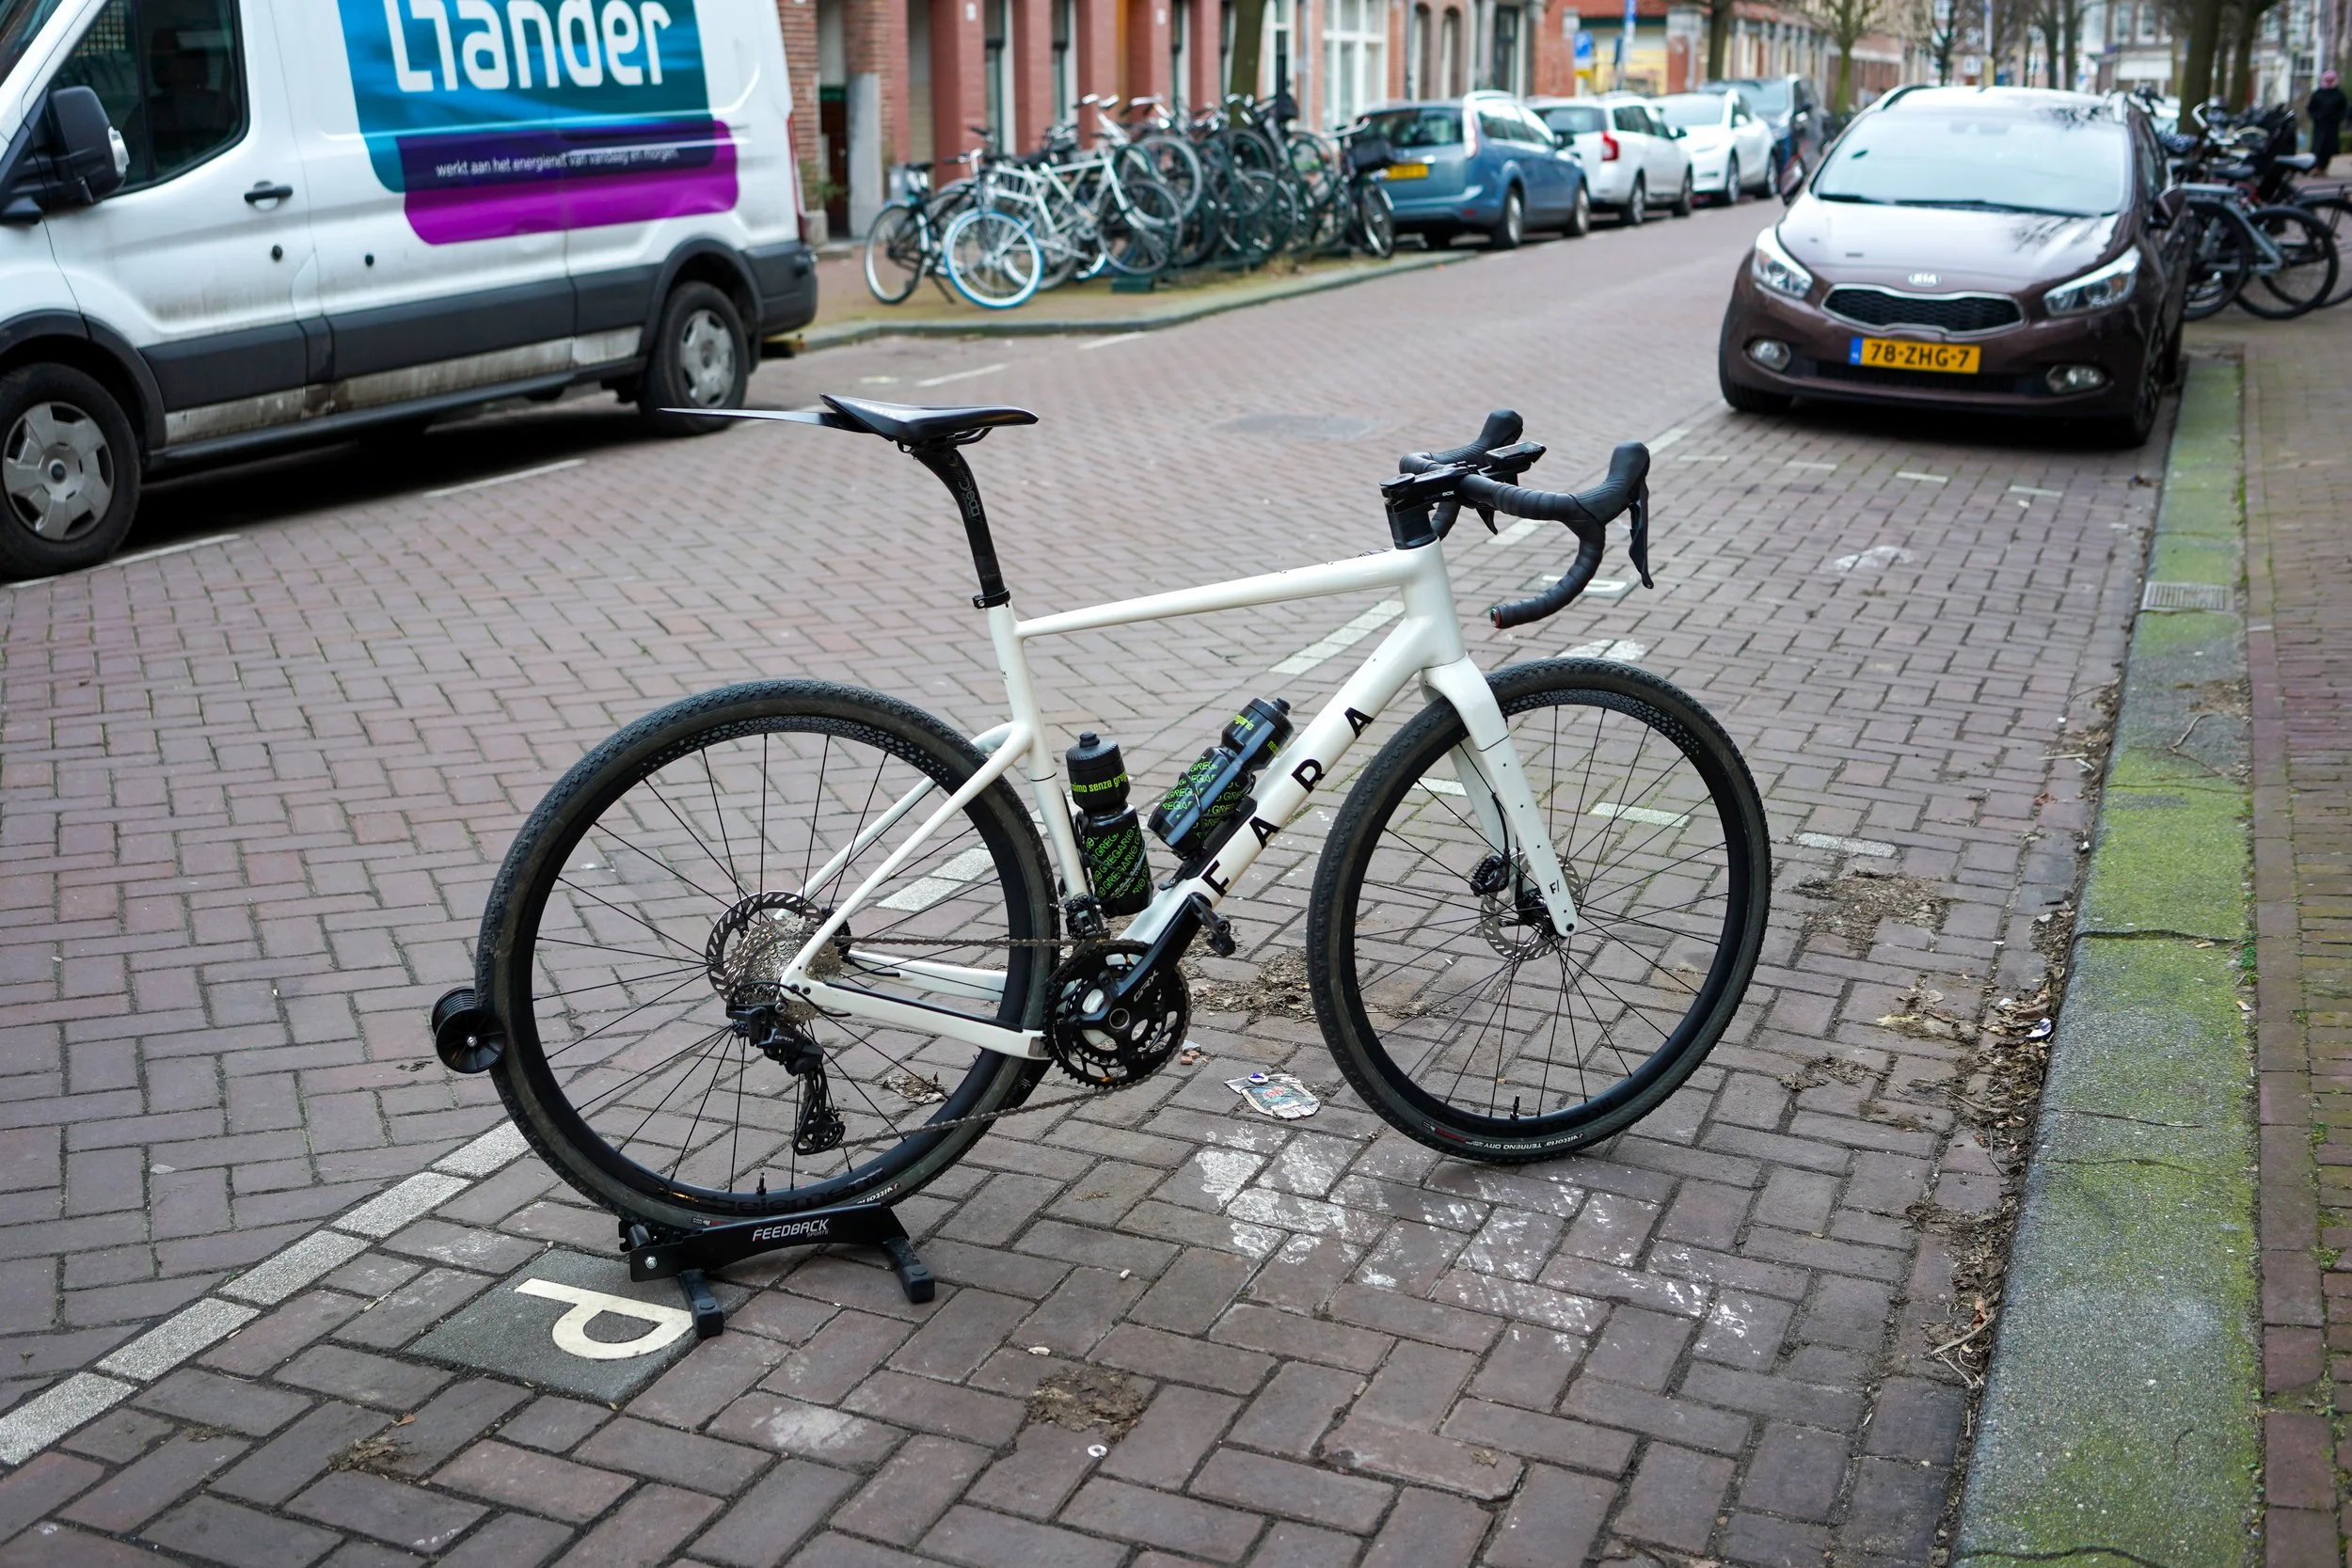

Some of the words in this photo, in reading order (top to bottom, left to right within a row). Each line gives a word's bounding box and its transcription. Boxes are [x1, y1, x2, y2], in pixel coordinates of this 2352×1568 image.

[436, 158, 469, 177] werkt
[470, 160, 491, 175] aan
[492, 156, 511, 173] het
[1871, 343, 1971, 369] 78-ZHG-7
[1089, 779, 1112, 792] senza
[1201, 707, 1375, 898] FARA
[1133, 970, 1160, 1003] GRX
[1483, 1141, 1502, 1149] DRY
[1502, 1142, 1542, 1150] TERRENO
[753, 1218, 830, 1242] FEEDBACK
[806, 1229, 829, 1238] SPORTS
[515, 1277, 693, 1360] P
